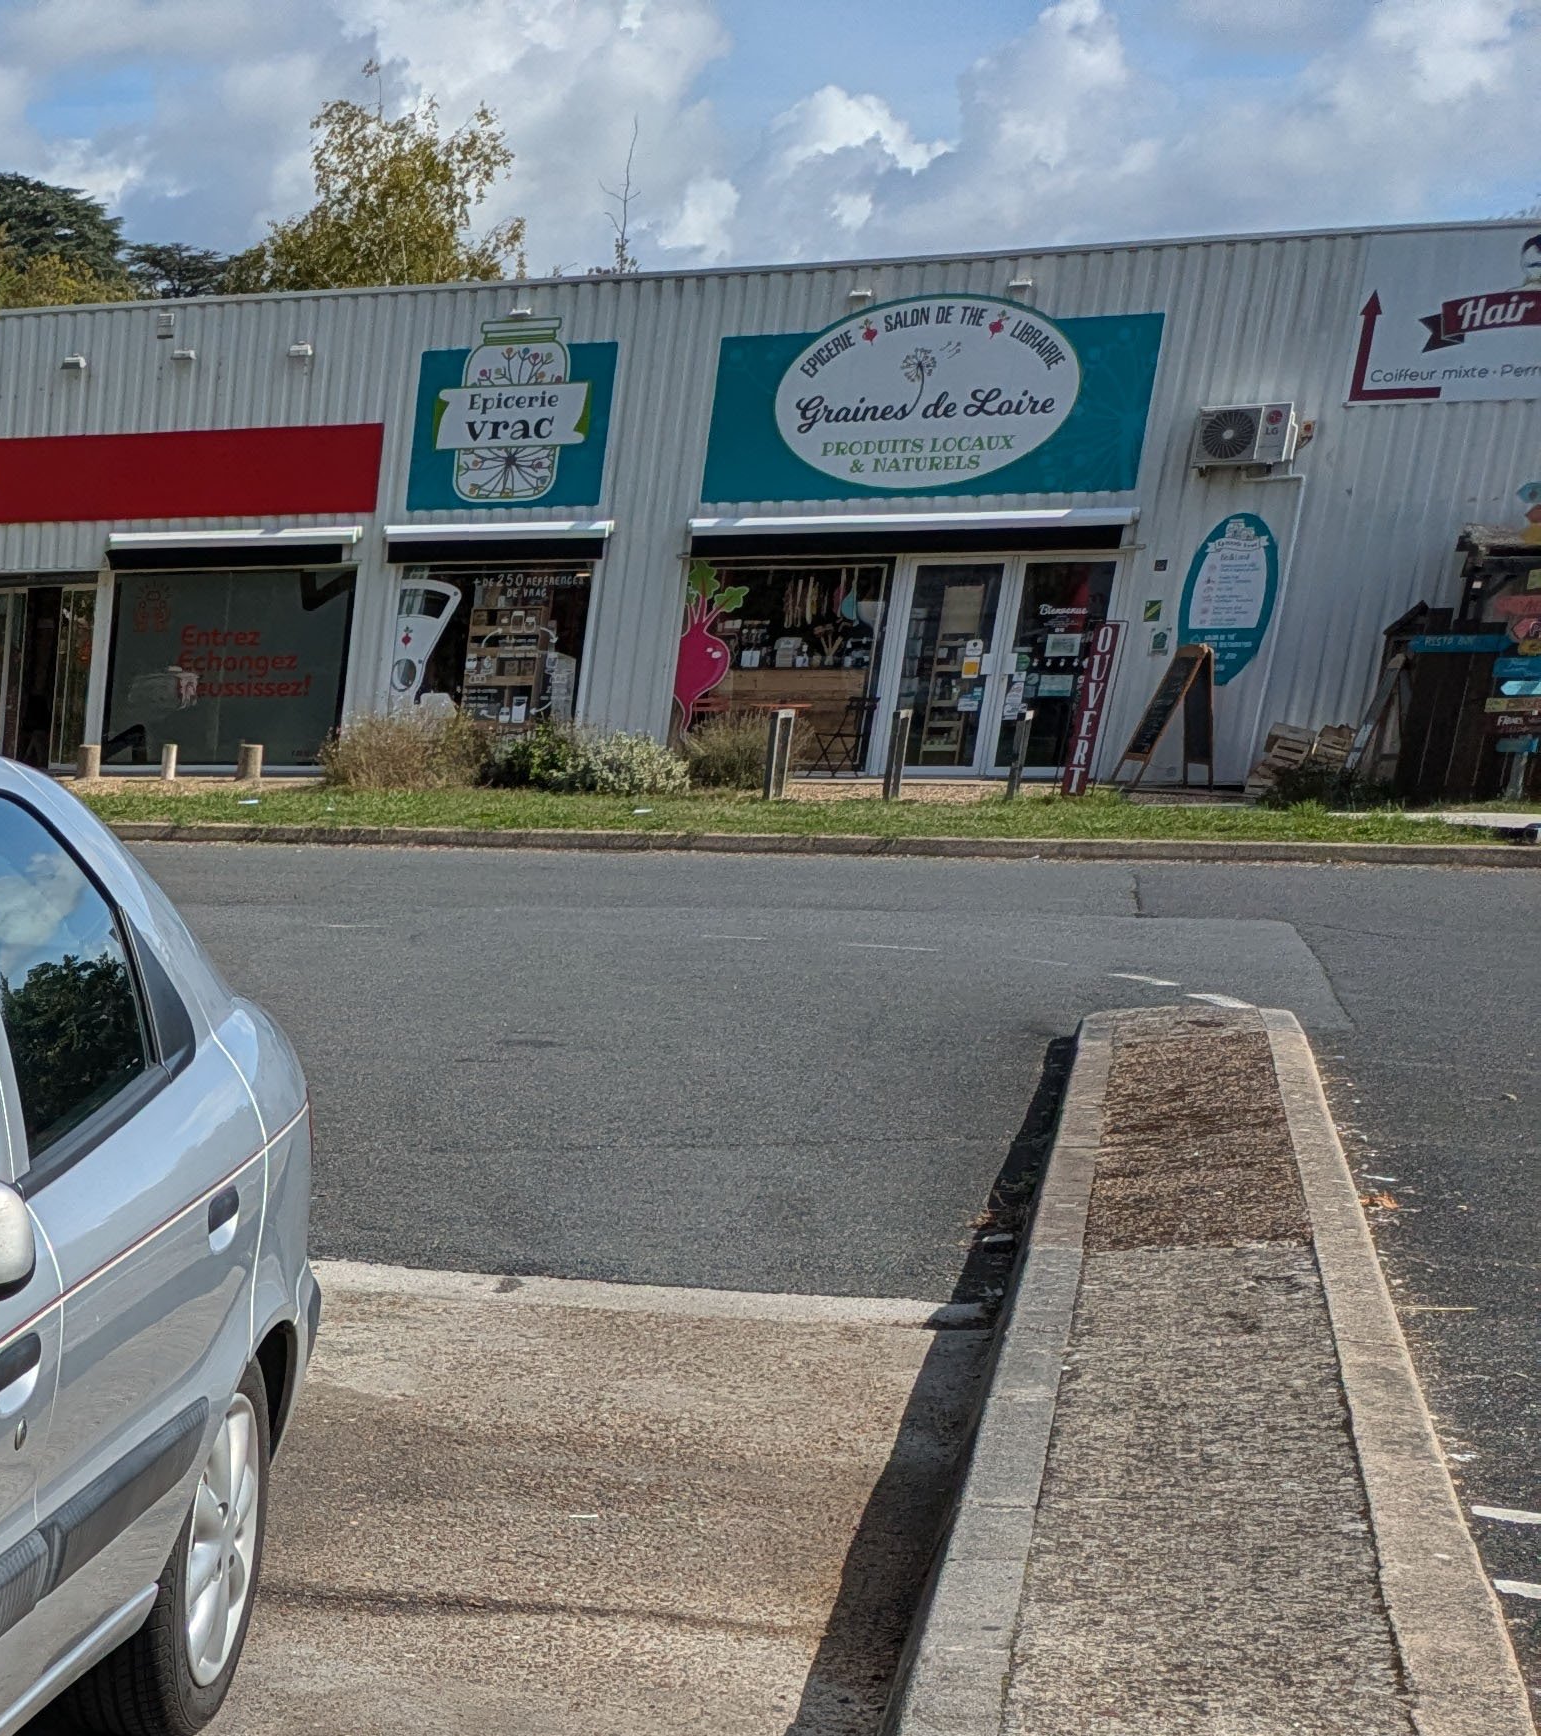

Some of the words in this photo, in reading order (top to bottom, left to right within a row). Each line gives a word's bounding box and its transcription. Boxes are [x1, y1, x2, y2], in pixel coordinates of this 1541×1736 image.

[1457, 295, 1536, 330] Hair
[800, 330, 856, 379] EPICERIE
[884, 307, 930, 333] SALON
[935, 306, 955, 325] DE
[960, 305, 989, 328] THE
[1010, 319, 1066, 371] LIBRAIRIE
[1371, 368, 1439, 383] Coiffeur
[1441, 366, 1489, 380] mixte
[468, 390, 559, 415] Epicerie
[796, 395, 910, 434] Graines
[921, 391, 957, 418] de
[963, 387, 1055, 417] Loire
[465, 416, 555, 442] vrac
[1265, 427, 1279, 436] LG
[820, 437, 925, 458] PRODUITS
[929, 434, 1018, 453] LOCAUX
[849, 457, 865, 474] &
[872, 454, 981, 473] NATURELS
[497, 574, 524, 588] 250
[506, 588, 519, 598] DE
[180, 624, 261, 647] Entrez
[1068, 626, 1113, 794] OUVERT
